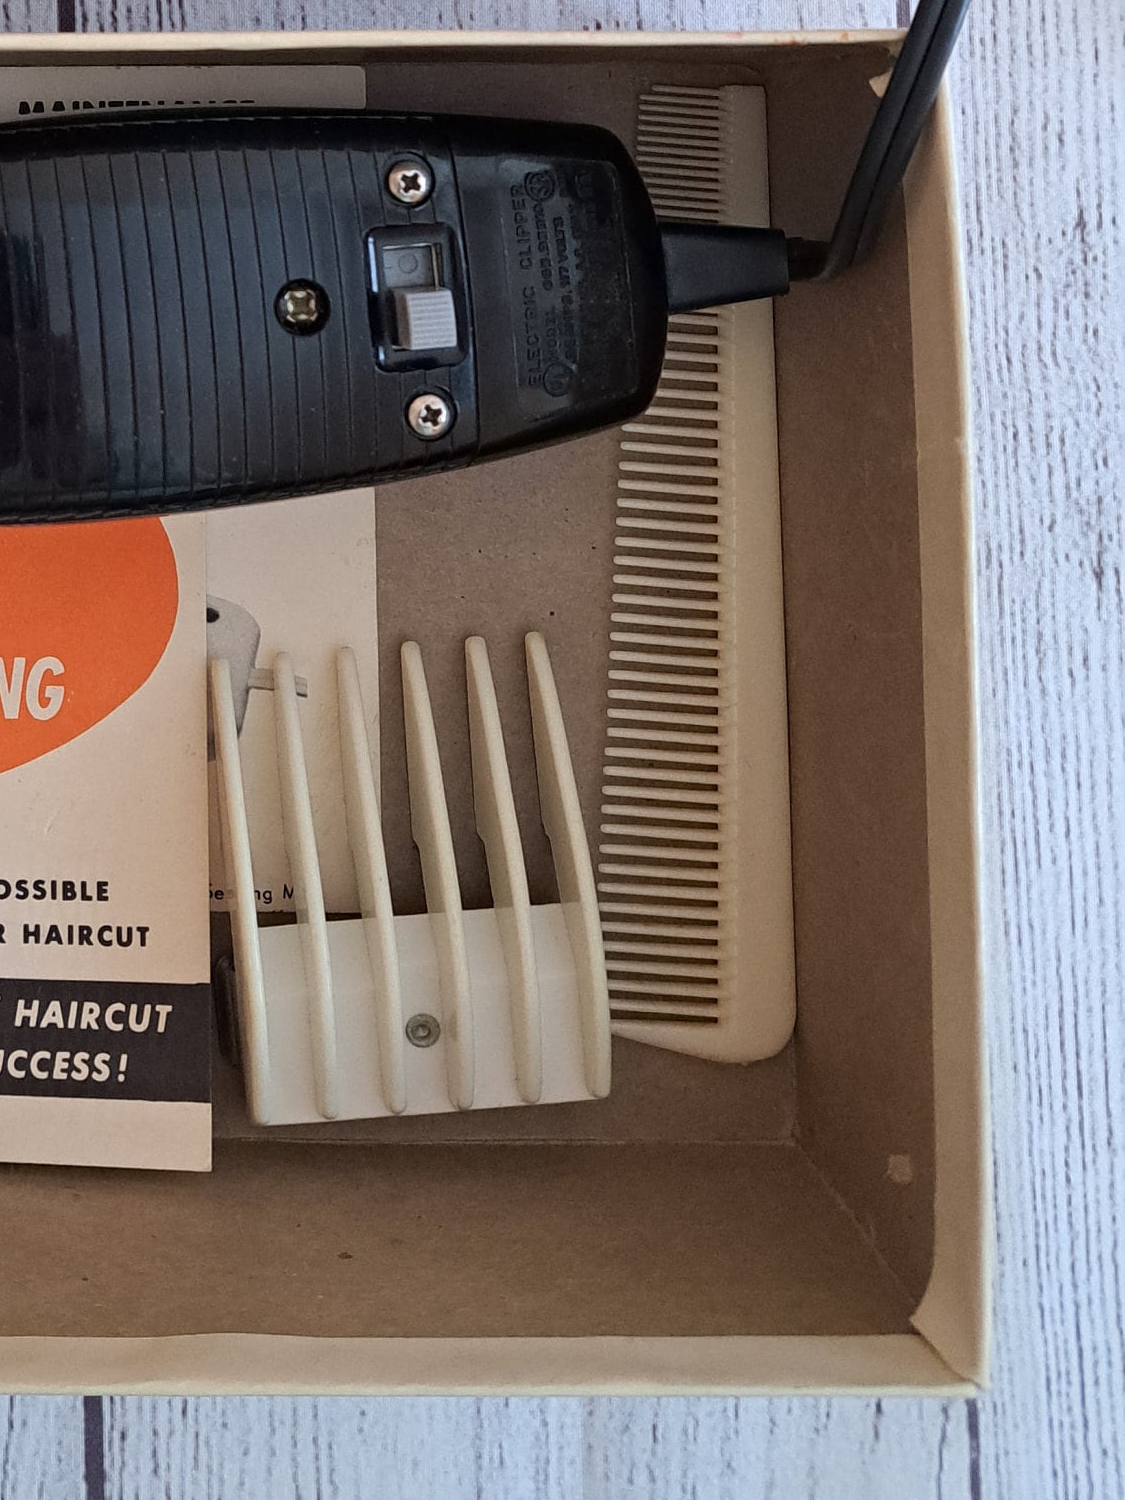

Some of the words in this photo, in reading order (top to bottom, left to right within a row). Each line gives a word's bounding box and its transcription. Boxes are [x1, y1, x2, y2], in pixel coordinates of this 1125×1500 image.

[511, 184, 532, 269] CLIPPER
[523, 286, 542, 386] ELECTRIC
[23, 923, 150, 948] HAIRCUT
[14, 999, 173, 1033] HAIRCUT
